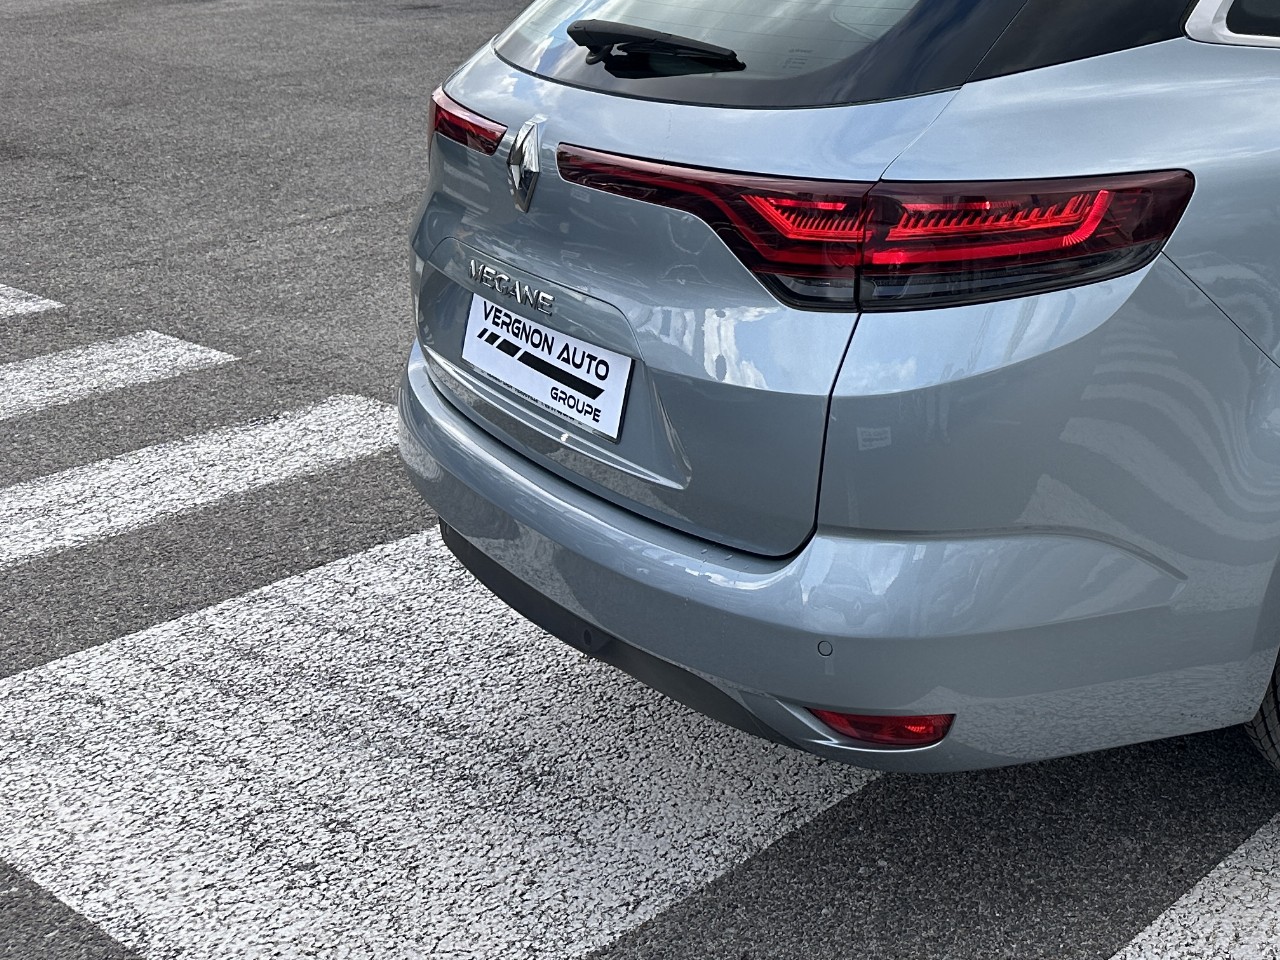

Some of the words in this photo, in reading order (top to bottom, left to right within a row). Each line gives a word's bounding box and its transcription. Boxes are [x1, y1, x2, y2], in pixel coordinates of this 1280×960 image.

[468, 259, 555, 316] MEGANE
[483, 300, 555, 356] VERGNON
[557, 343, 610, 381] AUTO
[550, 386, 602, 423] GROUPE
